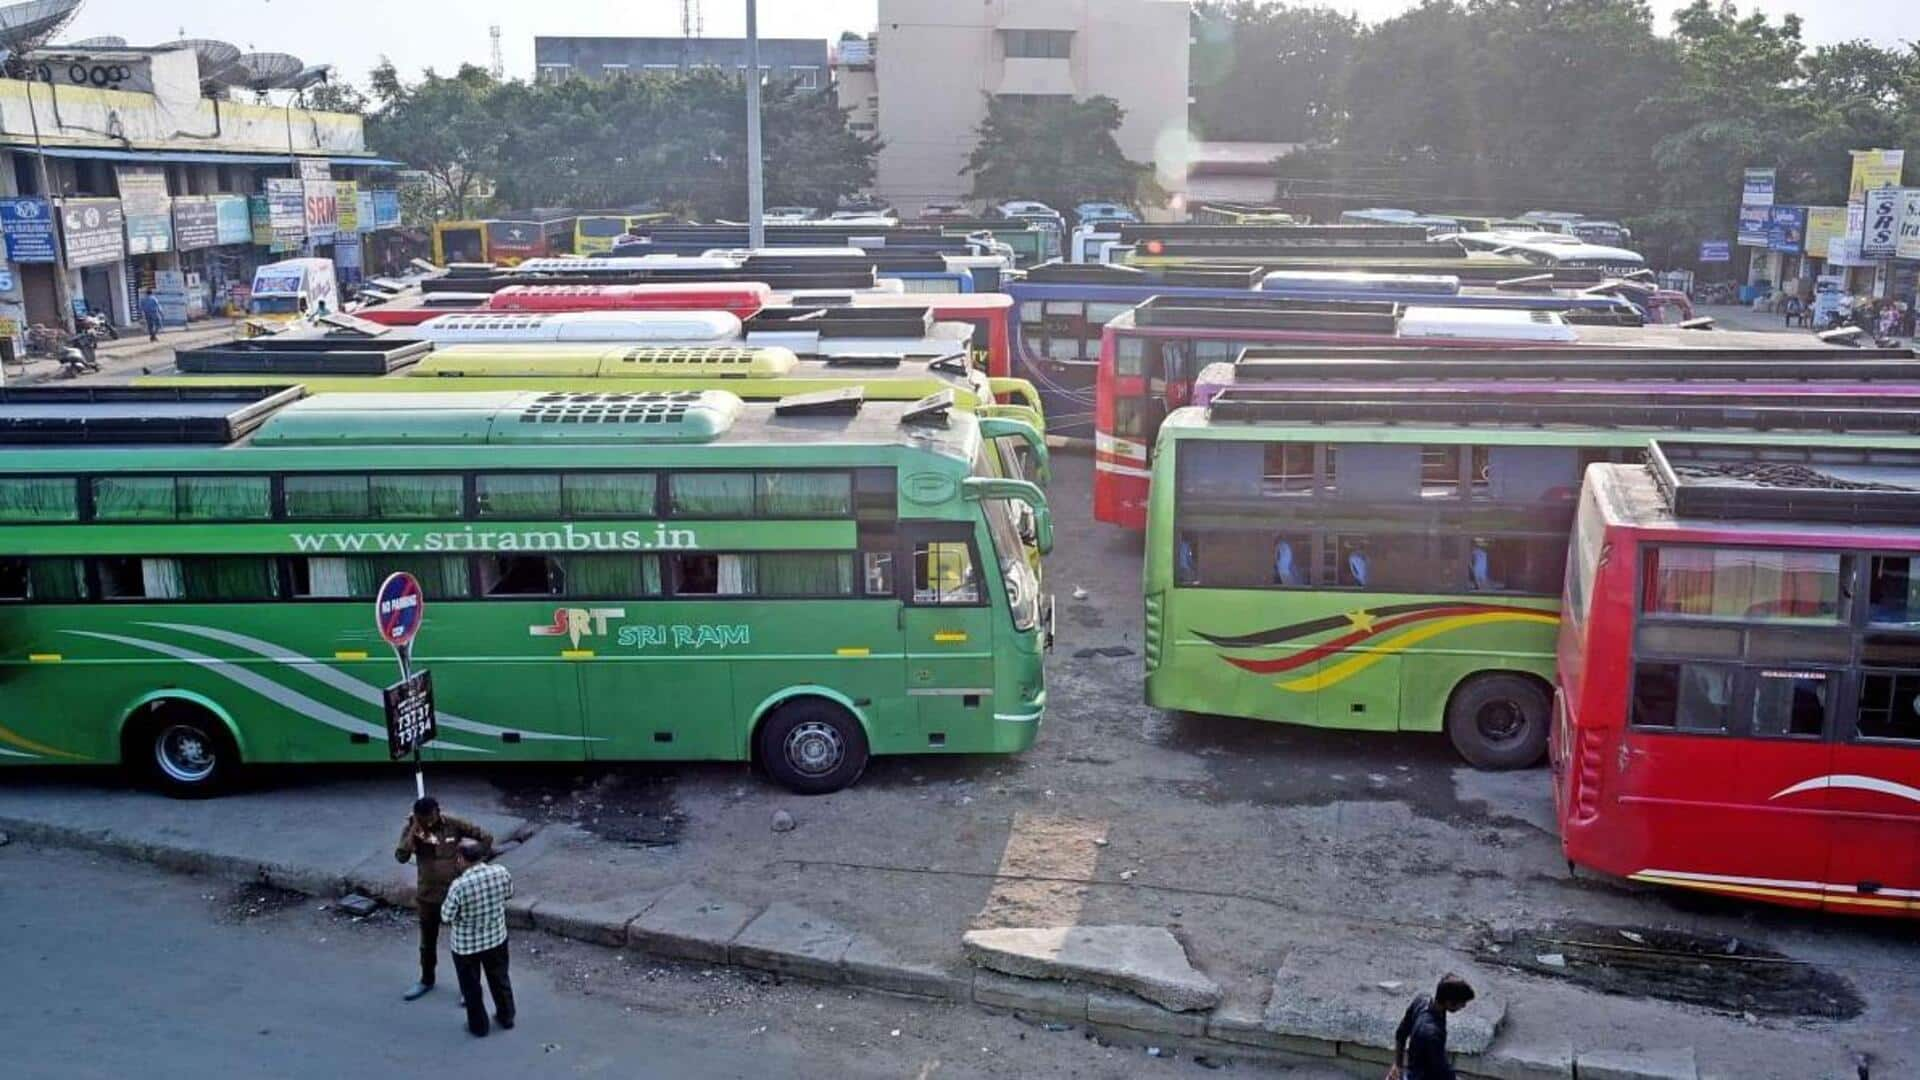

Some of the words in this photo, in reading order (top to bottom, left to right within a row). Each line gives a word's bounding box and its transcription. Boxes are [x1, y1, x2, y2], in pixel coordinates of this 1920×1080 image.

[308, 196, 337, 225] SRM
[290, 523, 699, 551] www.srirambus.in
[529, 608, 625, 649] SRT
[618, 625, 667, 649] SRI
[671, 624, 750, 649] RAM
